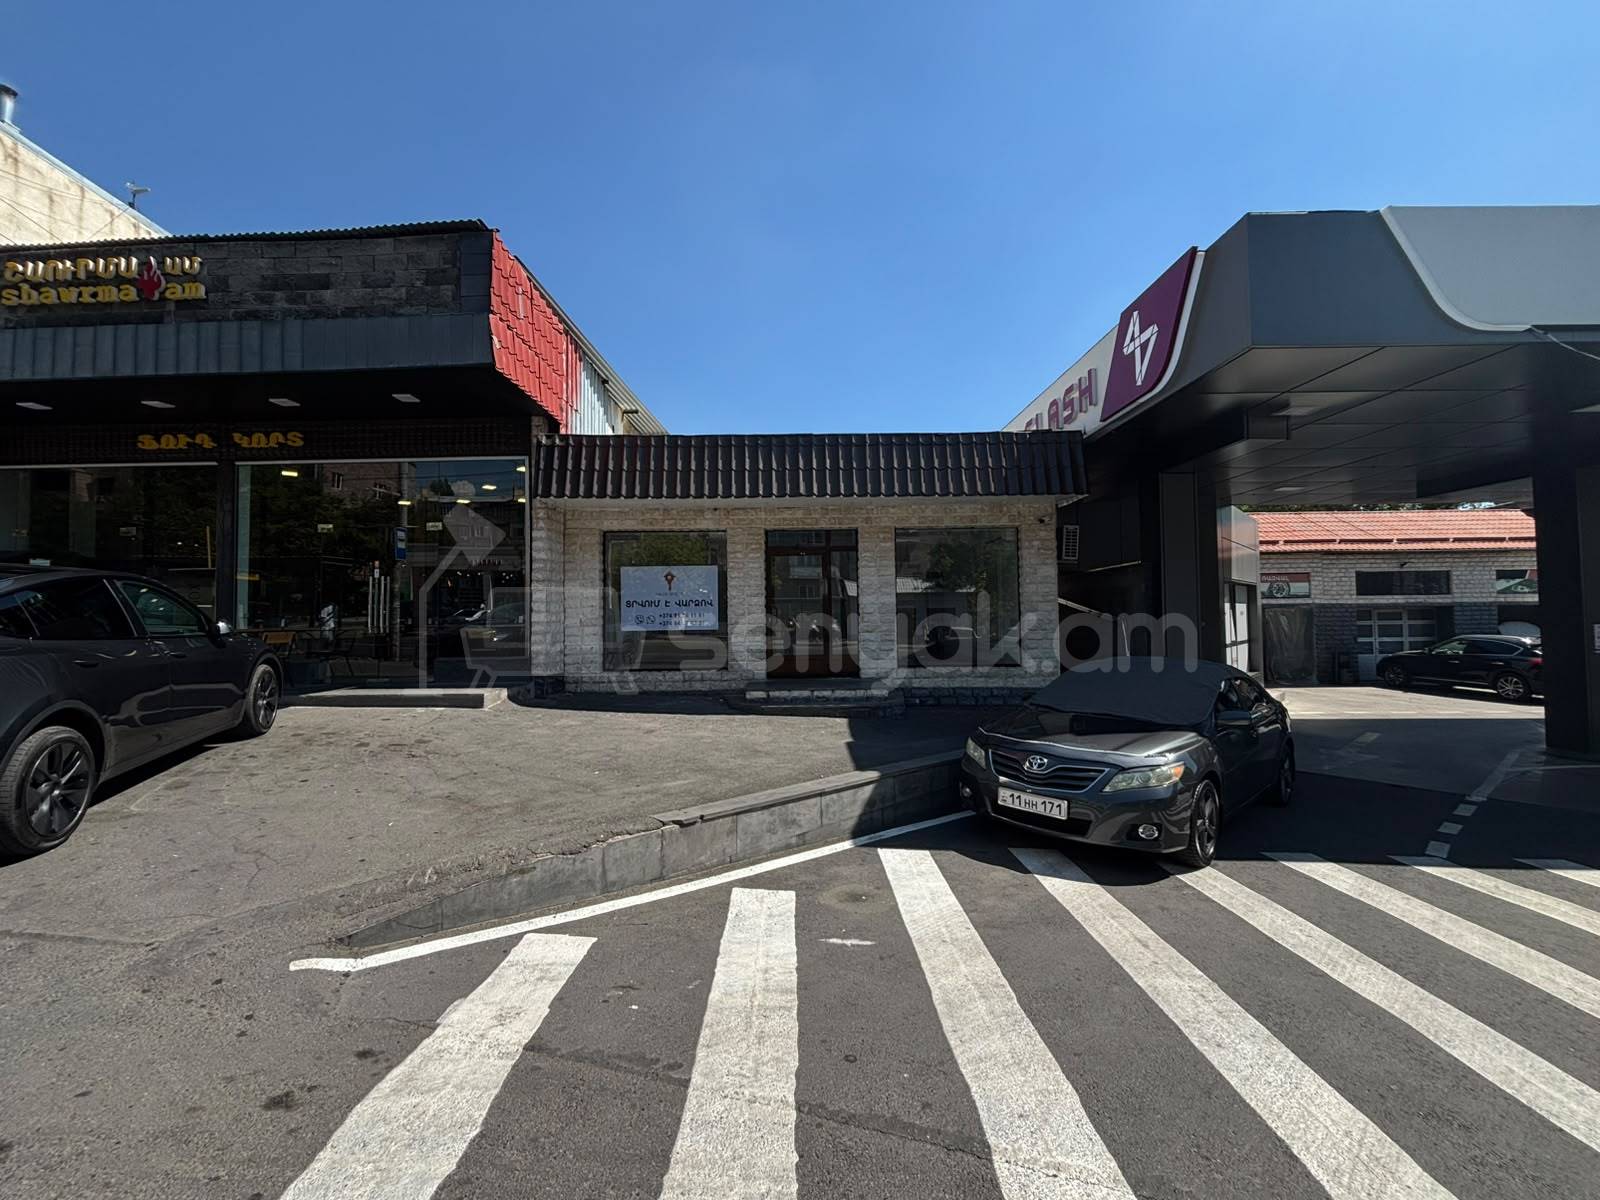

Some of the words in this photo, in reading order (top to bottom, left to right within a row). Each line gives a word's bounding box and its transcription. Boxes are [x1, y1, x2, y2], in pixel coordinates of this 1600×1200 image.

[1, 282, 140, 305] shawrma
[165, 281, 206, 300] am
[1024, 368, 1098, 431] ASH
[625, 600, 661, 608] ՏՐՎՈՒՄ
[675, 600, 713, 608] ՎԱՐՁՈՎ
[1009, 793, 1022, 807] 11
[1024, 798, 1038, 810] HH
[1041, 800, 1062, 816] 171
